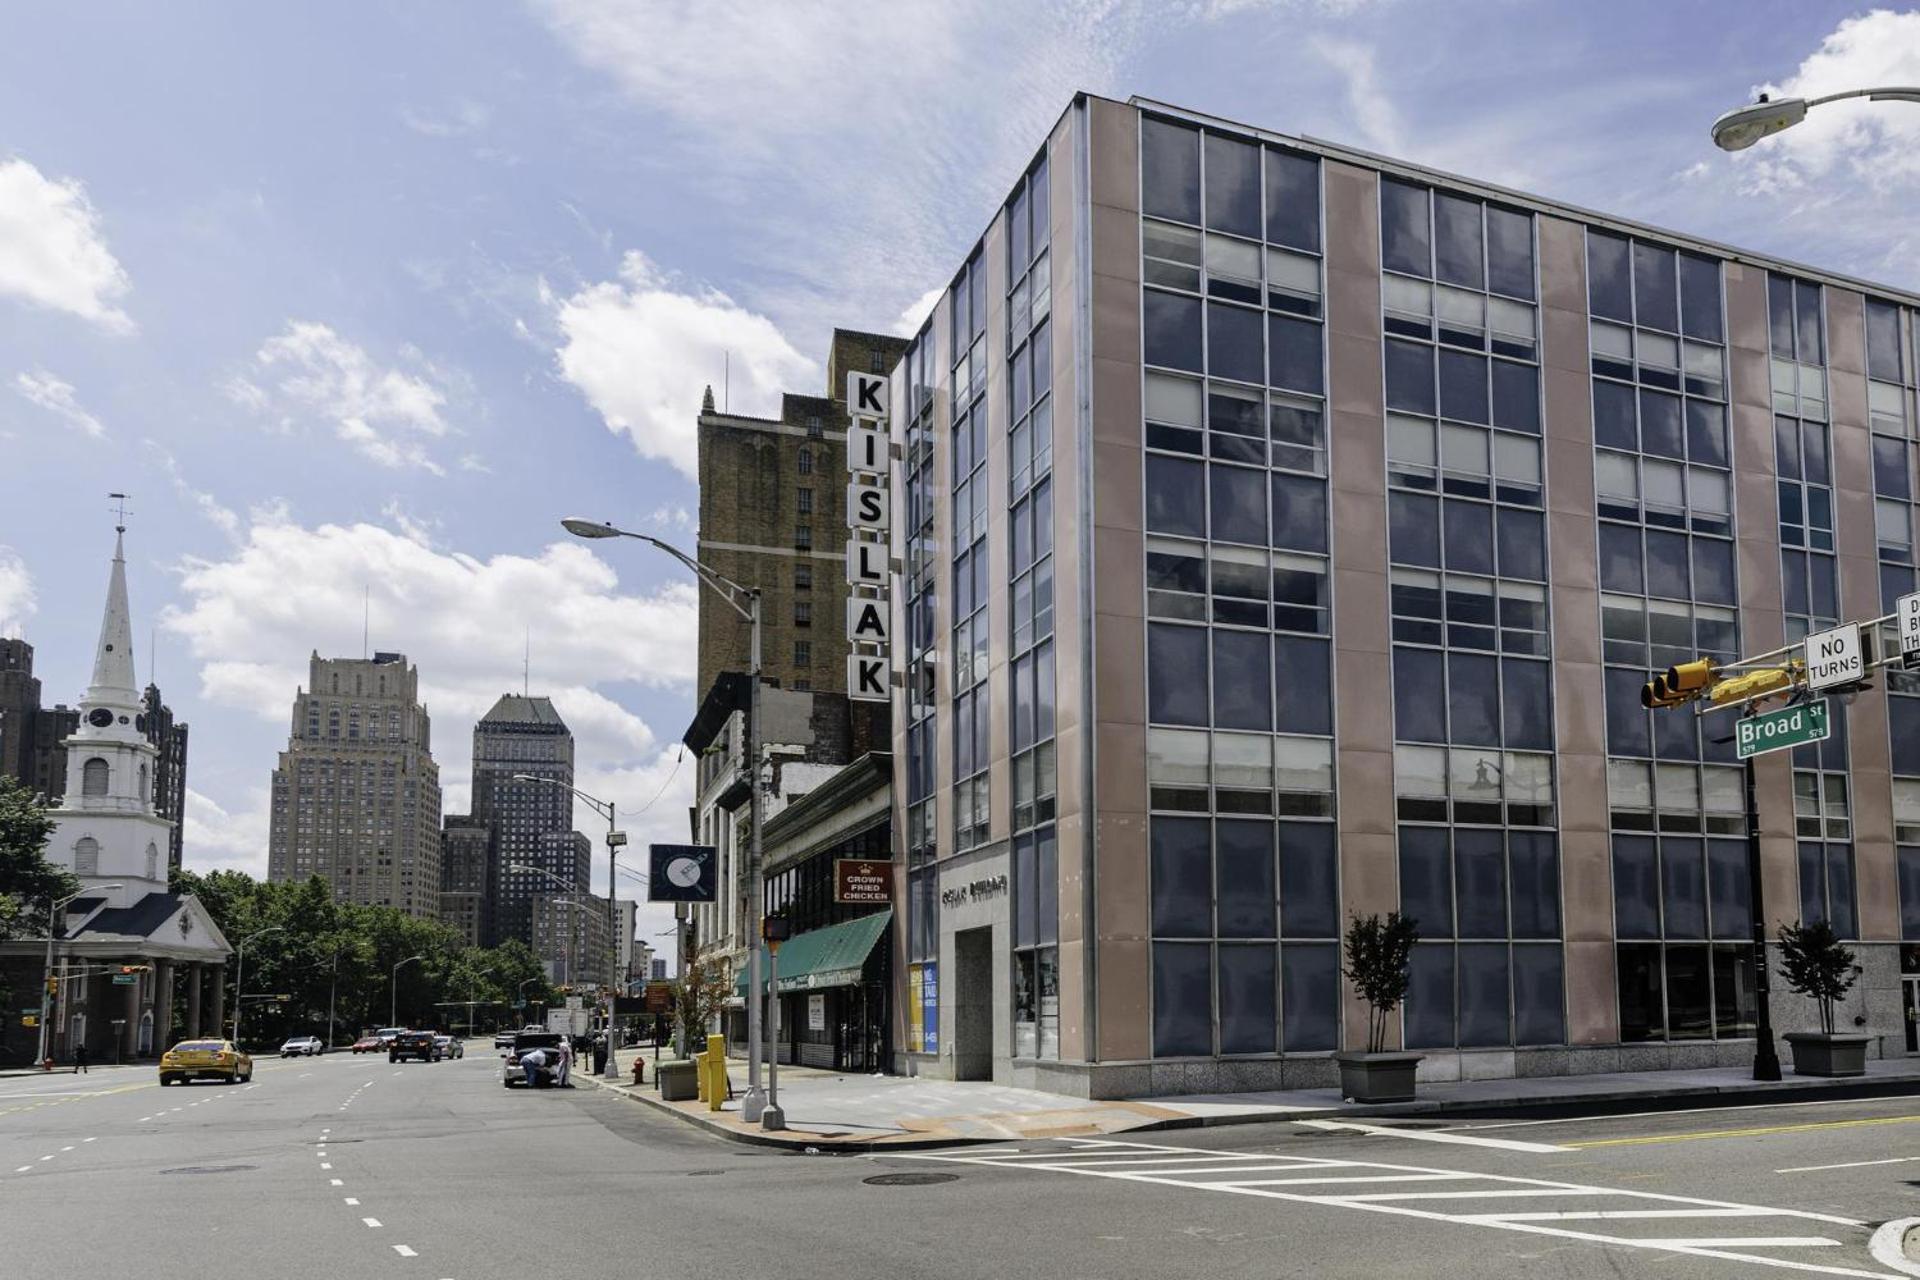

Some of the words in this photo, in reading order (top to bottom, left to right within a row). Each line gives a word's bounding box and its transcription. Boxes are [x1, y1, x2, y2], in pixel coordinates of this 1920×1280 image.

[855, 376, 885, 694] KISLAK
[1821, 639, 1845, 657] NO
[1810, 656, 1859, 680] TURNS
[1741, 711, 1802, 743] Broad
[1810, 706, 1822, 717] St
[846, 875, 884, 884] CROWN
[850, 884, 880, 892] FRIED
[843, 892, 888, 900] CHICKEN
